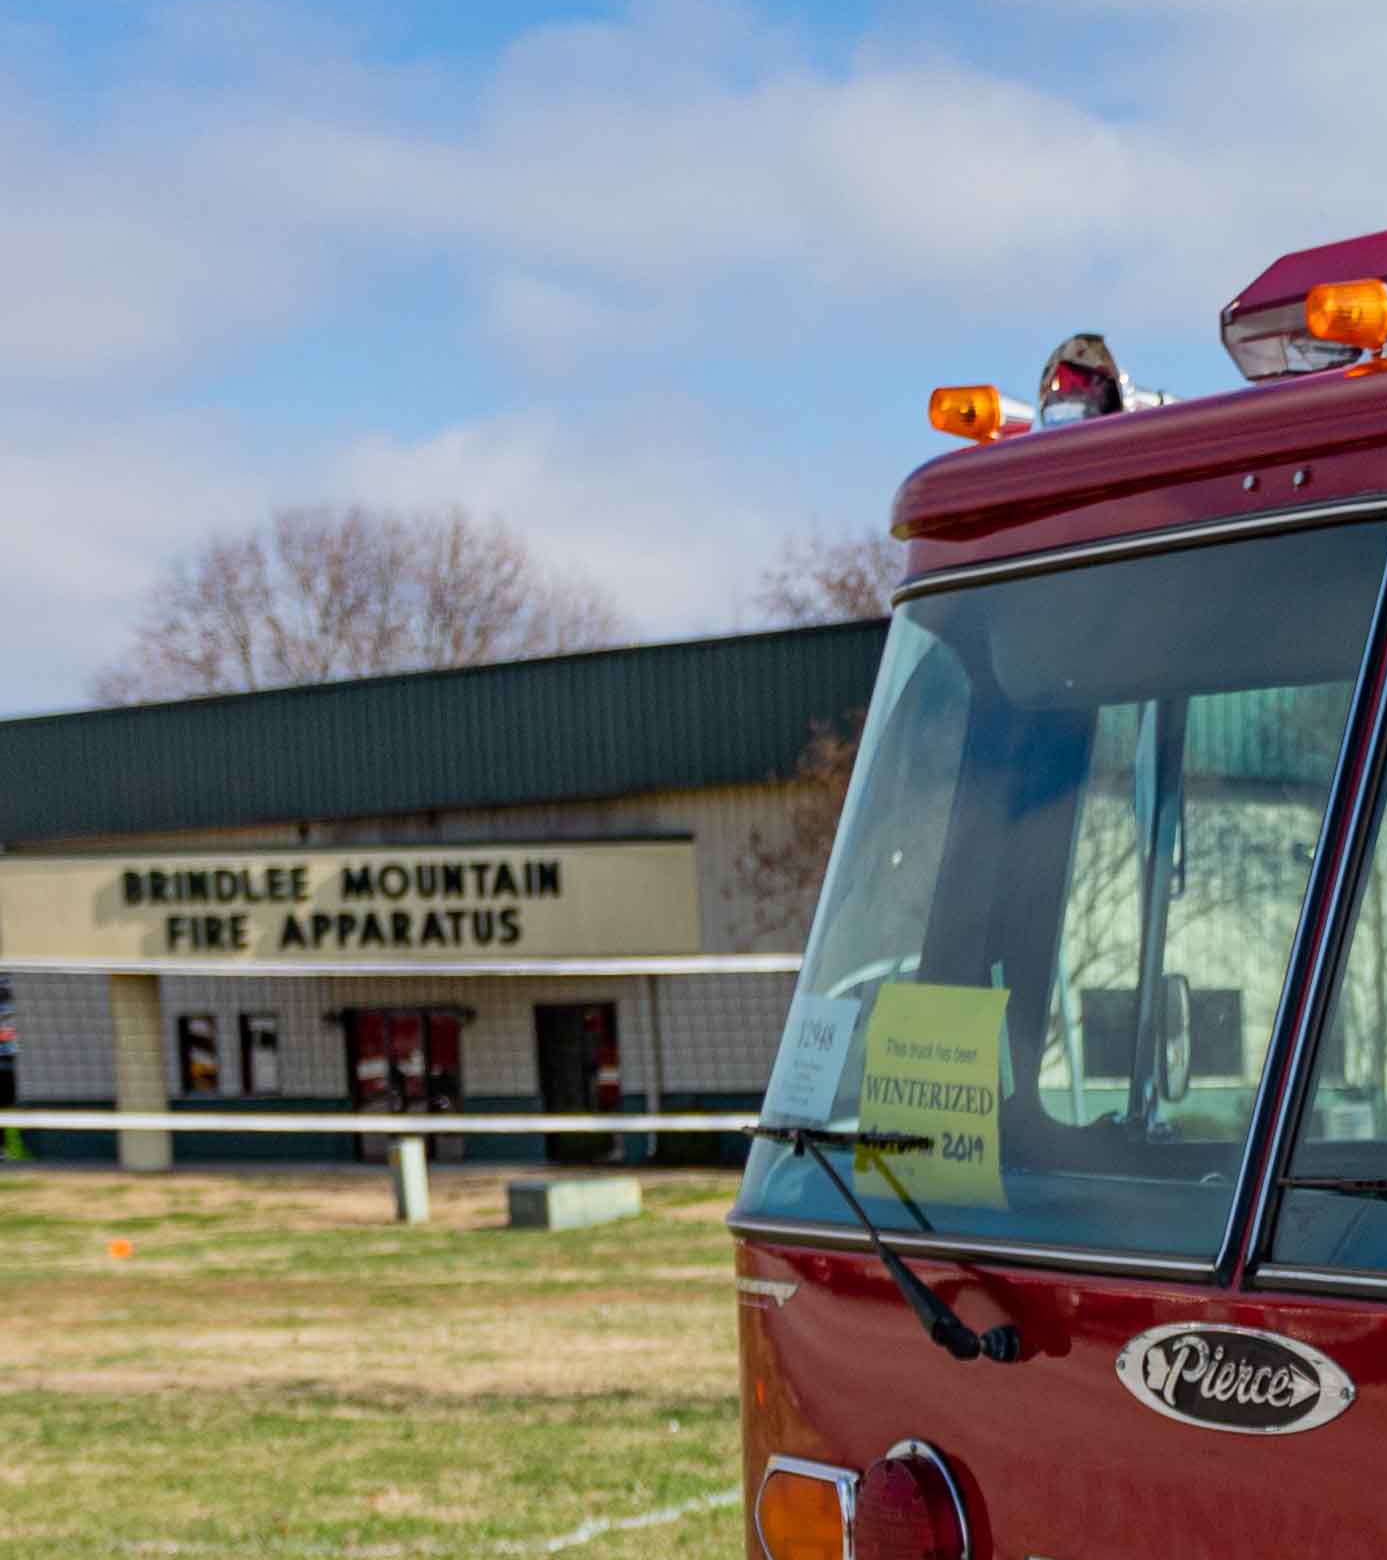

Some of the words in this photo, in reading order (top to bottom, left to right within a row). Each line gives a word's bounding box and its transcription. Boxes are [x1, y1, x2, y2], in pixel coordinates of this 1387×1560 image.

[122, 867, 309, 904] BRINDLEE
[341, 859, 562, 899] MOUNTAIN
[166, 912, 249, 952] FIRE
[277, 906, 522, 949] APPARATUS
[865, 1074, 994, 1116] WINTERIZED
[1161, 1333, 1296, 1408] Pierce
